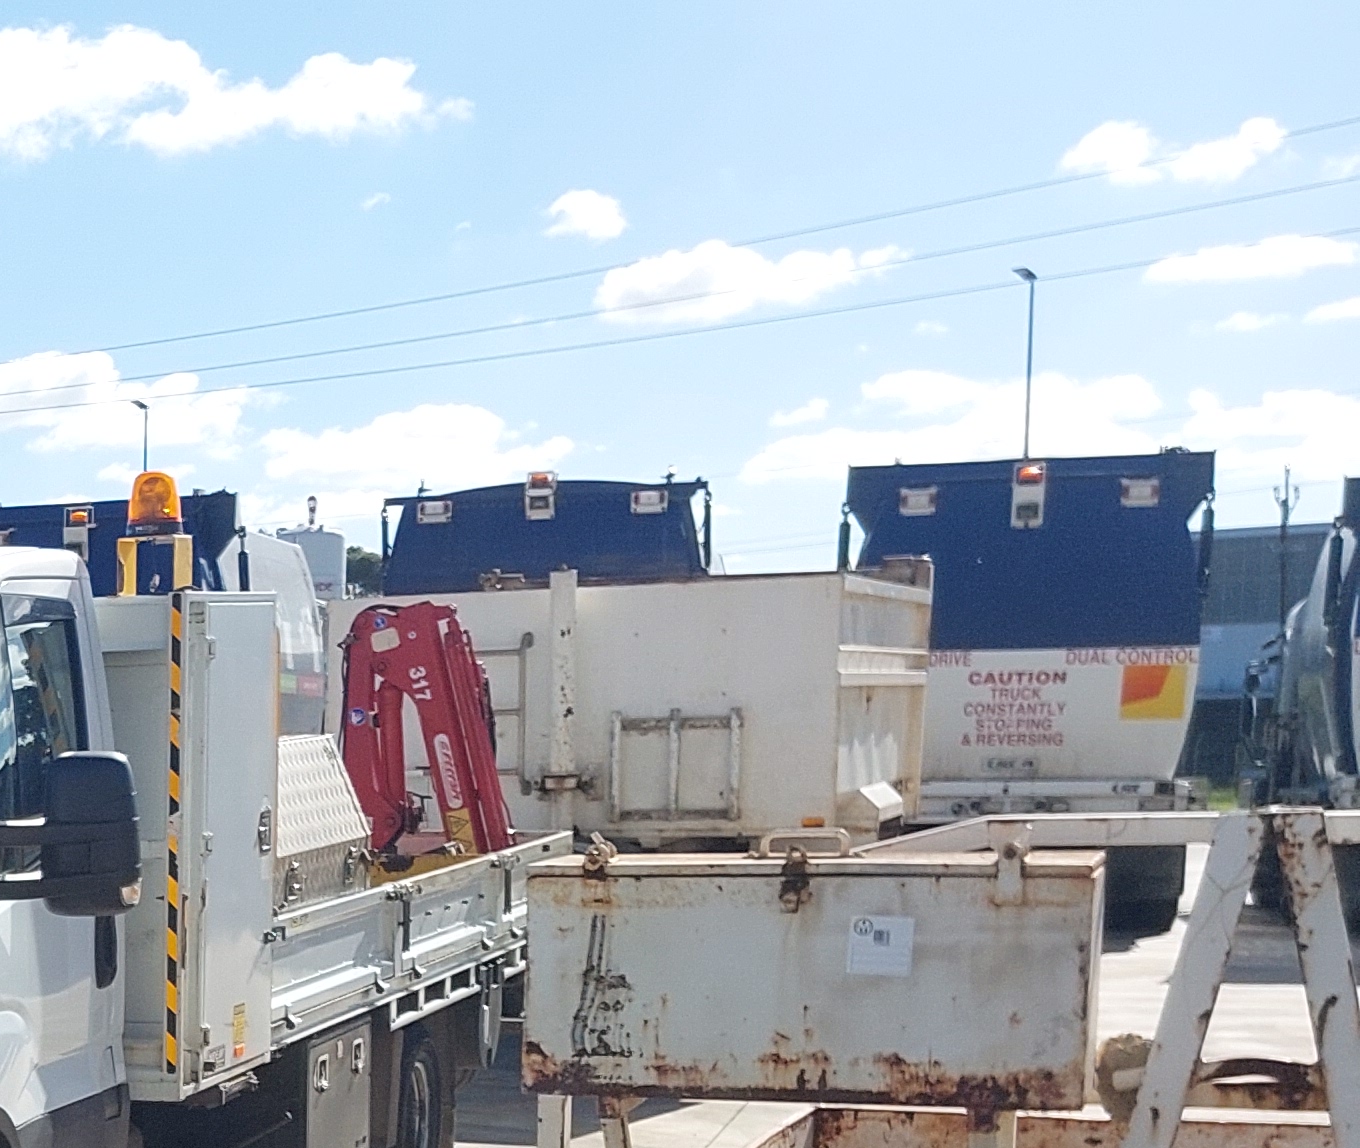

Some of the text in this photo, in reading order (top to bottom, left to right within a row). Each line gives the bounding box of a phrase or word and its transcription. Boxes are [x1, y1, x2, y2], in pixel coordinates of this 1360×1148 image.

[929, 650, 971, 667] DRIVE
[1065, 645, 1198, 665] DUAL CONTROL
[409, 666, 432, 700] 317
[968, 670, 1067, 686] CAUTION
[991, 687, 1041, 701] TRUCK
[963, 702, 1066, 717] CONSTANTLY
[961, 733, 1063, 747] & REVERSING
